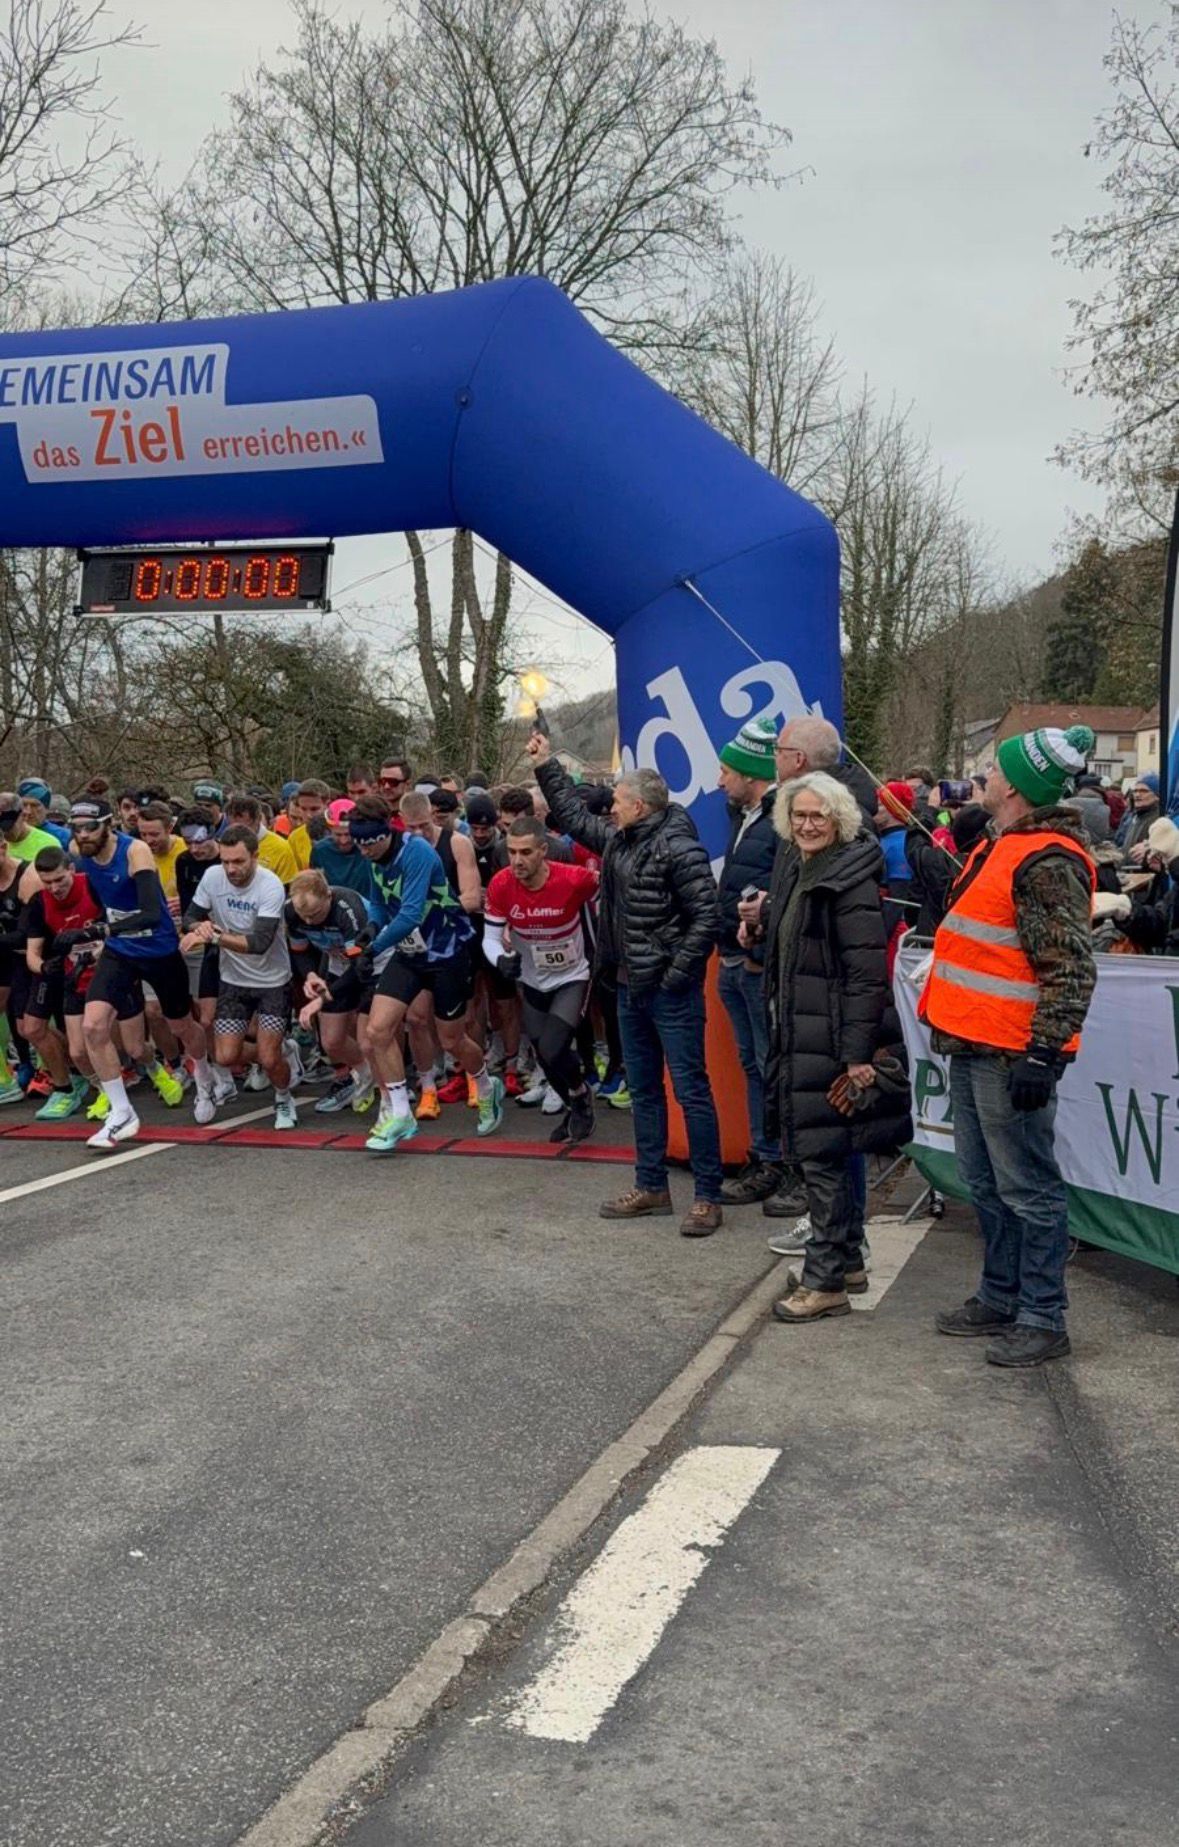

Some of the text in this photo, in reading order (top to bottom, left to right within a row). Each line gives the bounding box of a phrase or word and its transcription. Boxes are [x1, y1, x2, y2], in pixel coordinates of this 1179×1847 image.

[0, 355, 216, 407] EMEINSAM
[33, 406, 366, 468] das Ziel erreichen.«
[135, 557, 299, 600] 0:00:00
[545, 952, 564, 964] 50
